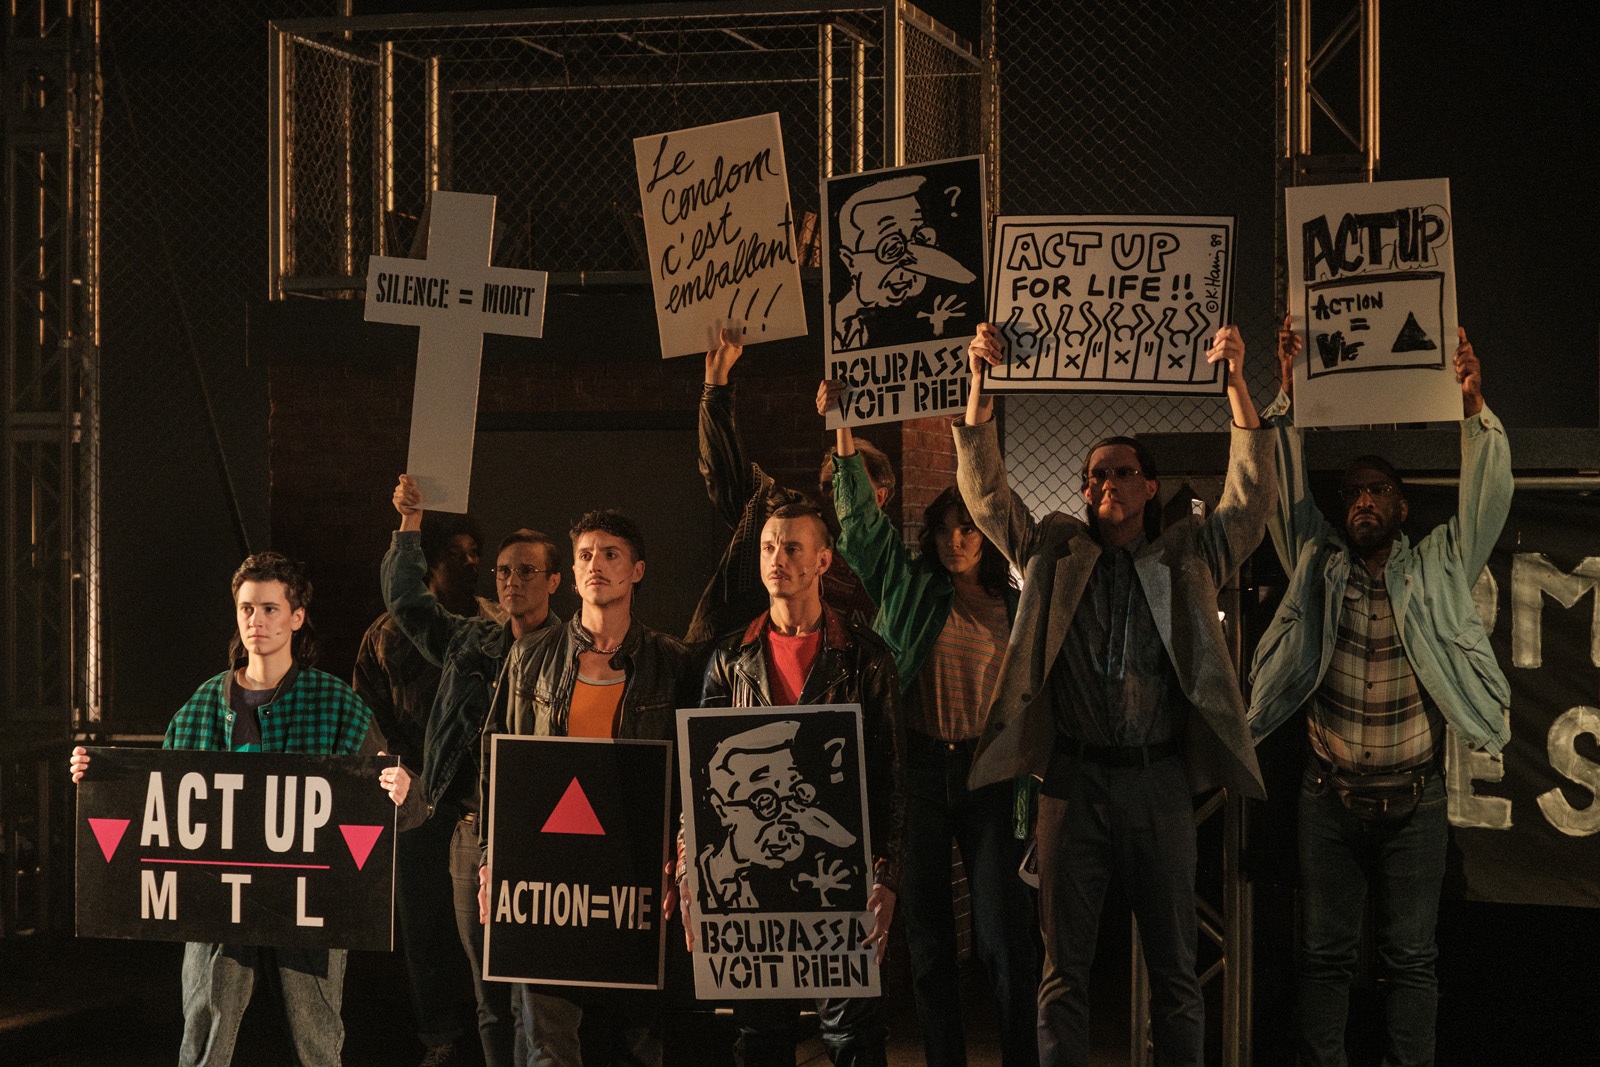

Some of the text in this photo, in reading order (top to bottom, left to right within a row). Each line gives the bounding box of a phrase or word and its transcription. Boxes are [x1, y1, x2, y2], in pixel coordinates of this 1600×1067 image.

[647, 134, 695, 193] Le
[665, 202, 797, 314] emballant
[1006, 231, 1180, 273] ACT UP
[376, 272, 450, 309] SILENCE
[482, 283, 536, 317] MORT
[1012, 275, 1072, 302] FOR
[1311, 291, 1383, 320] ACTION
[831, 345, 972, 388] BOURASS
[140, 771, 333, 853] ACT UP
[700, 918, 873, 954] BOURASSA
